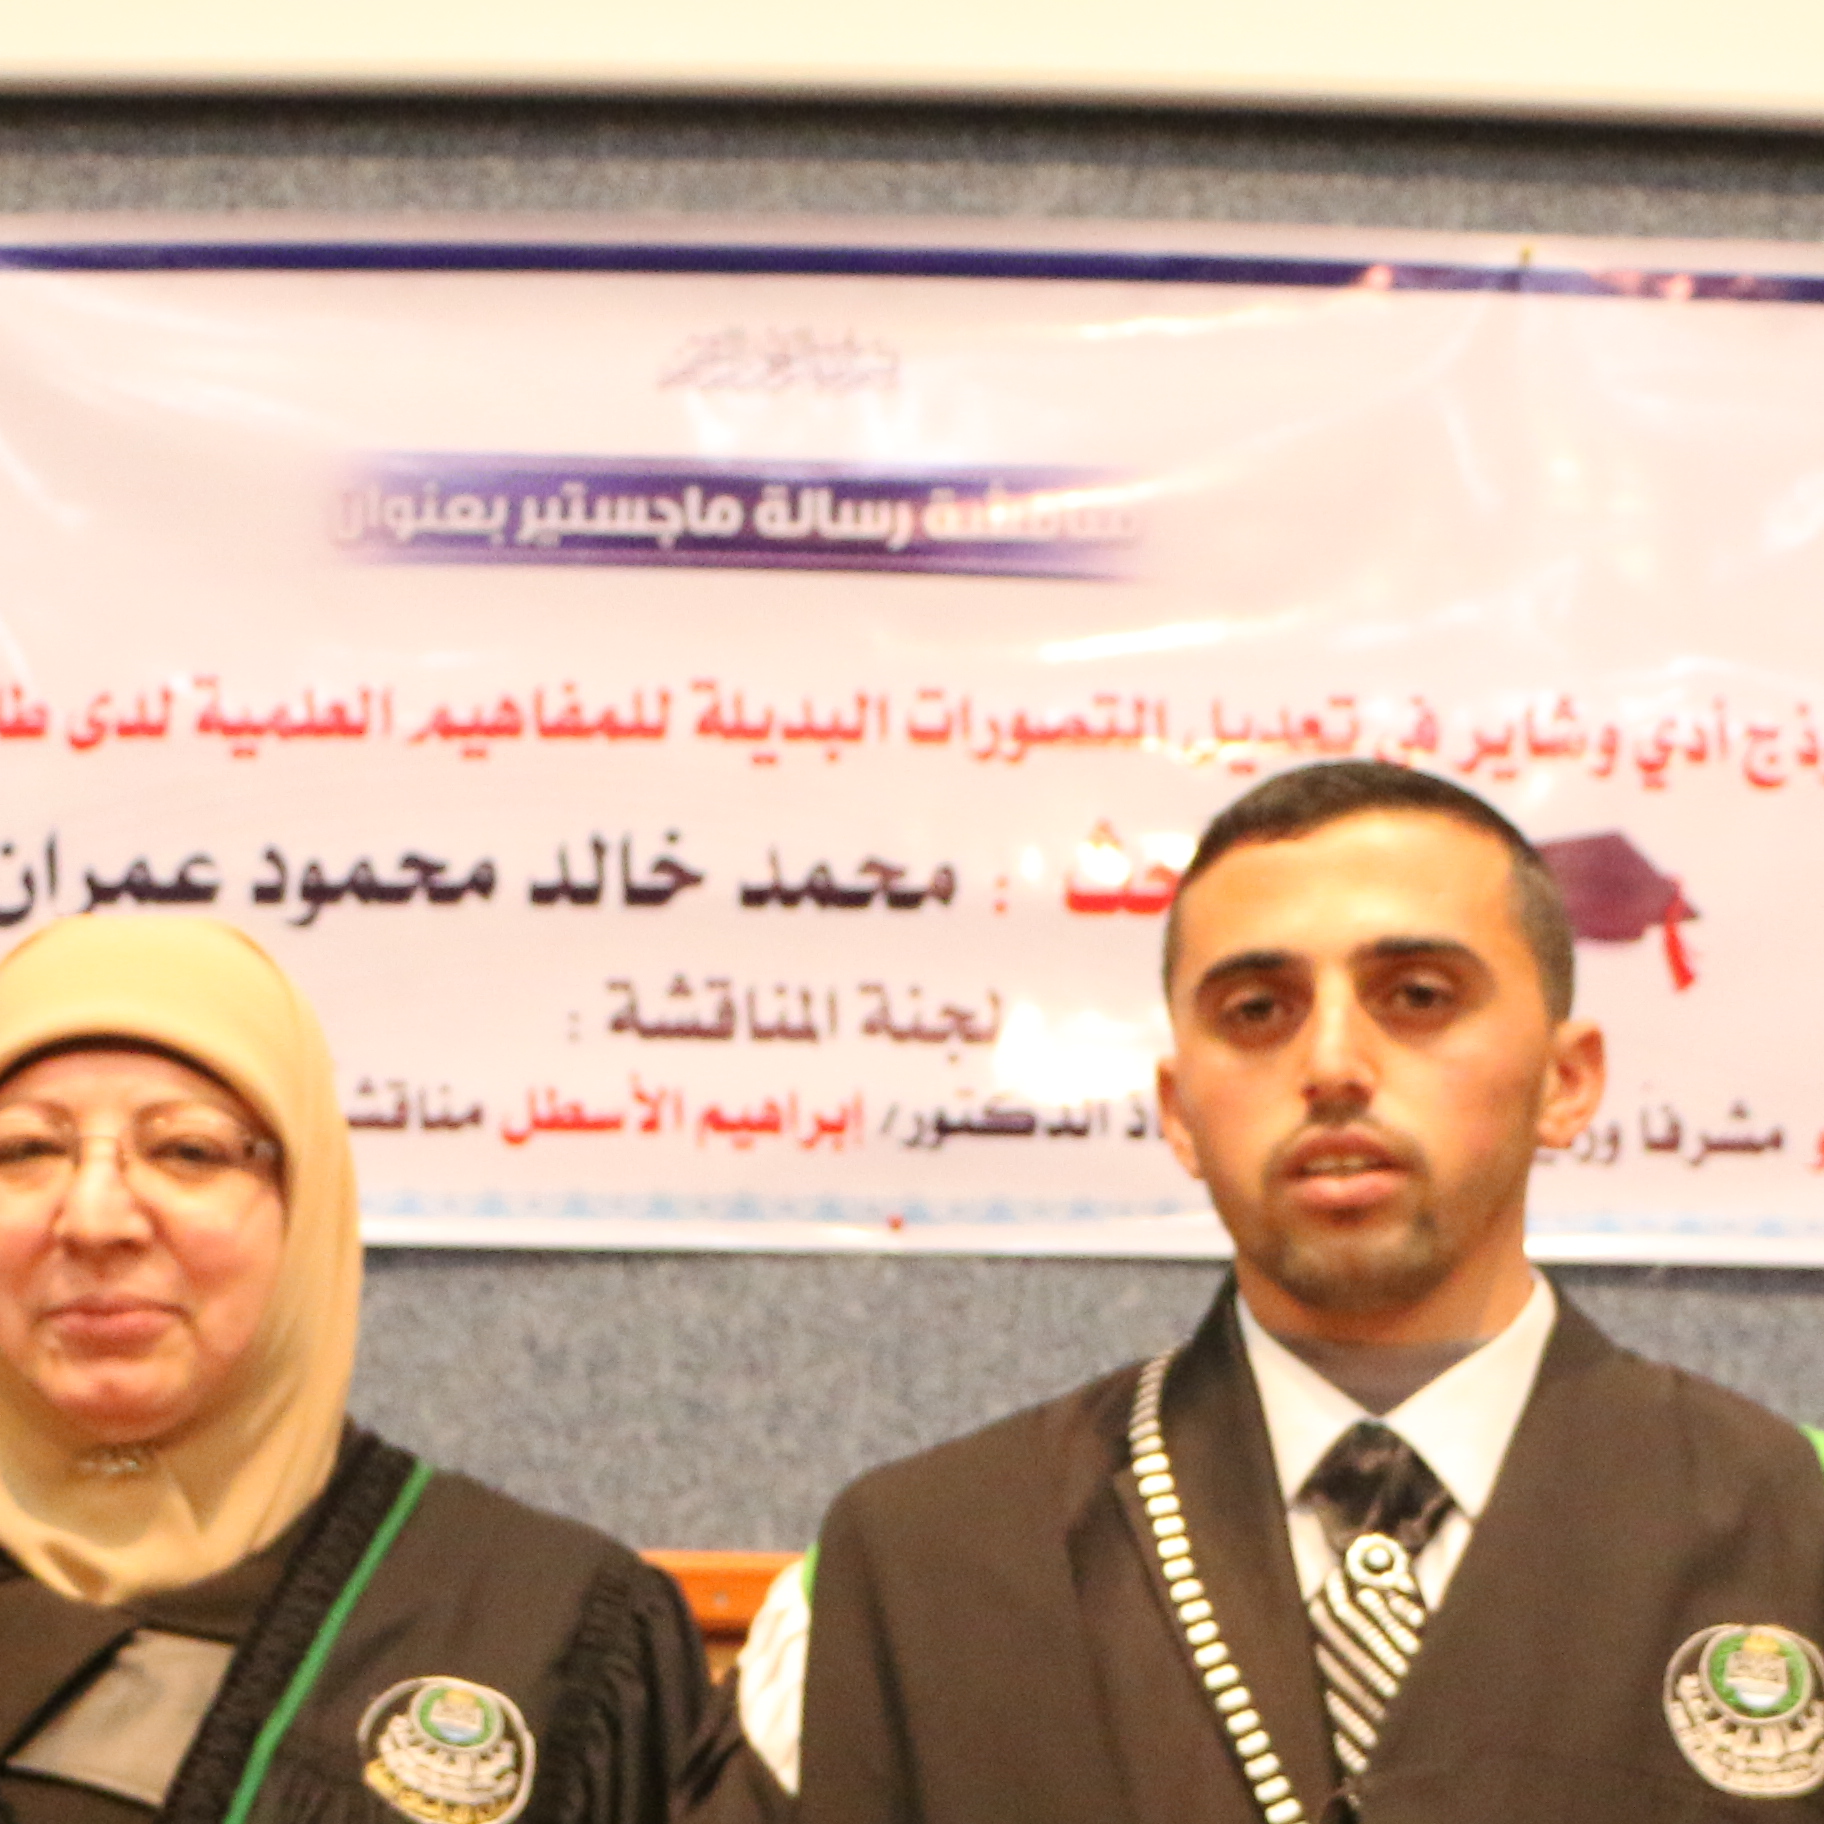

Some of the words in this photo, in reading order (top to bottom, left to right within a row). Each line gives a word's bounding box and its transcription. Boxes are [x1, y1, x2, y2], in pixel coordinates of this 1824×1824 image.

[516, 480, 748, 552] ماجستير
[752, 480, 914, 552] رسالة
[65, 689, 173, 755] لدى
[193, 678, 392, 762] العلمية
[407, 683, 672, 762] للمفاهيم
[691, 680, 888, 769] البديلة
[905, 689, 1168, 768] التصورات
[1452, 696, 1622, 786] وشاير
[1631, 701, 1730, 796] أدي
[250, 847, 498, 930] محمود
[527, 831, 705, 911] خالد
[737, 854, 957, 914] محمد
[606, 974, 840, 1046] المناقشة
[500, 1072, 688, 1150] الأسطل
[696, 1086, 868, 1154] إبراهيم
